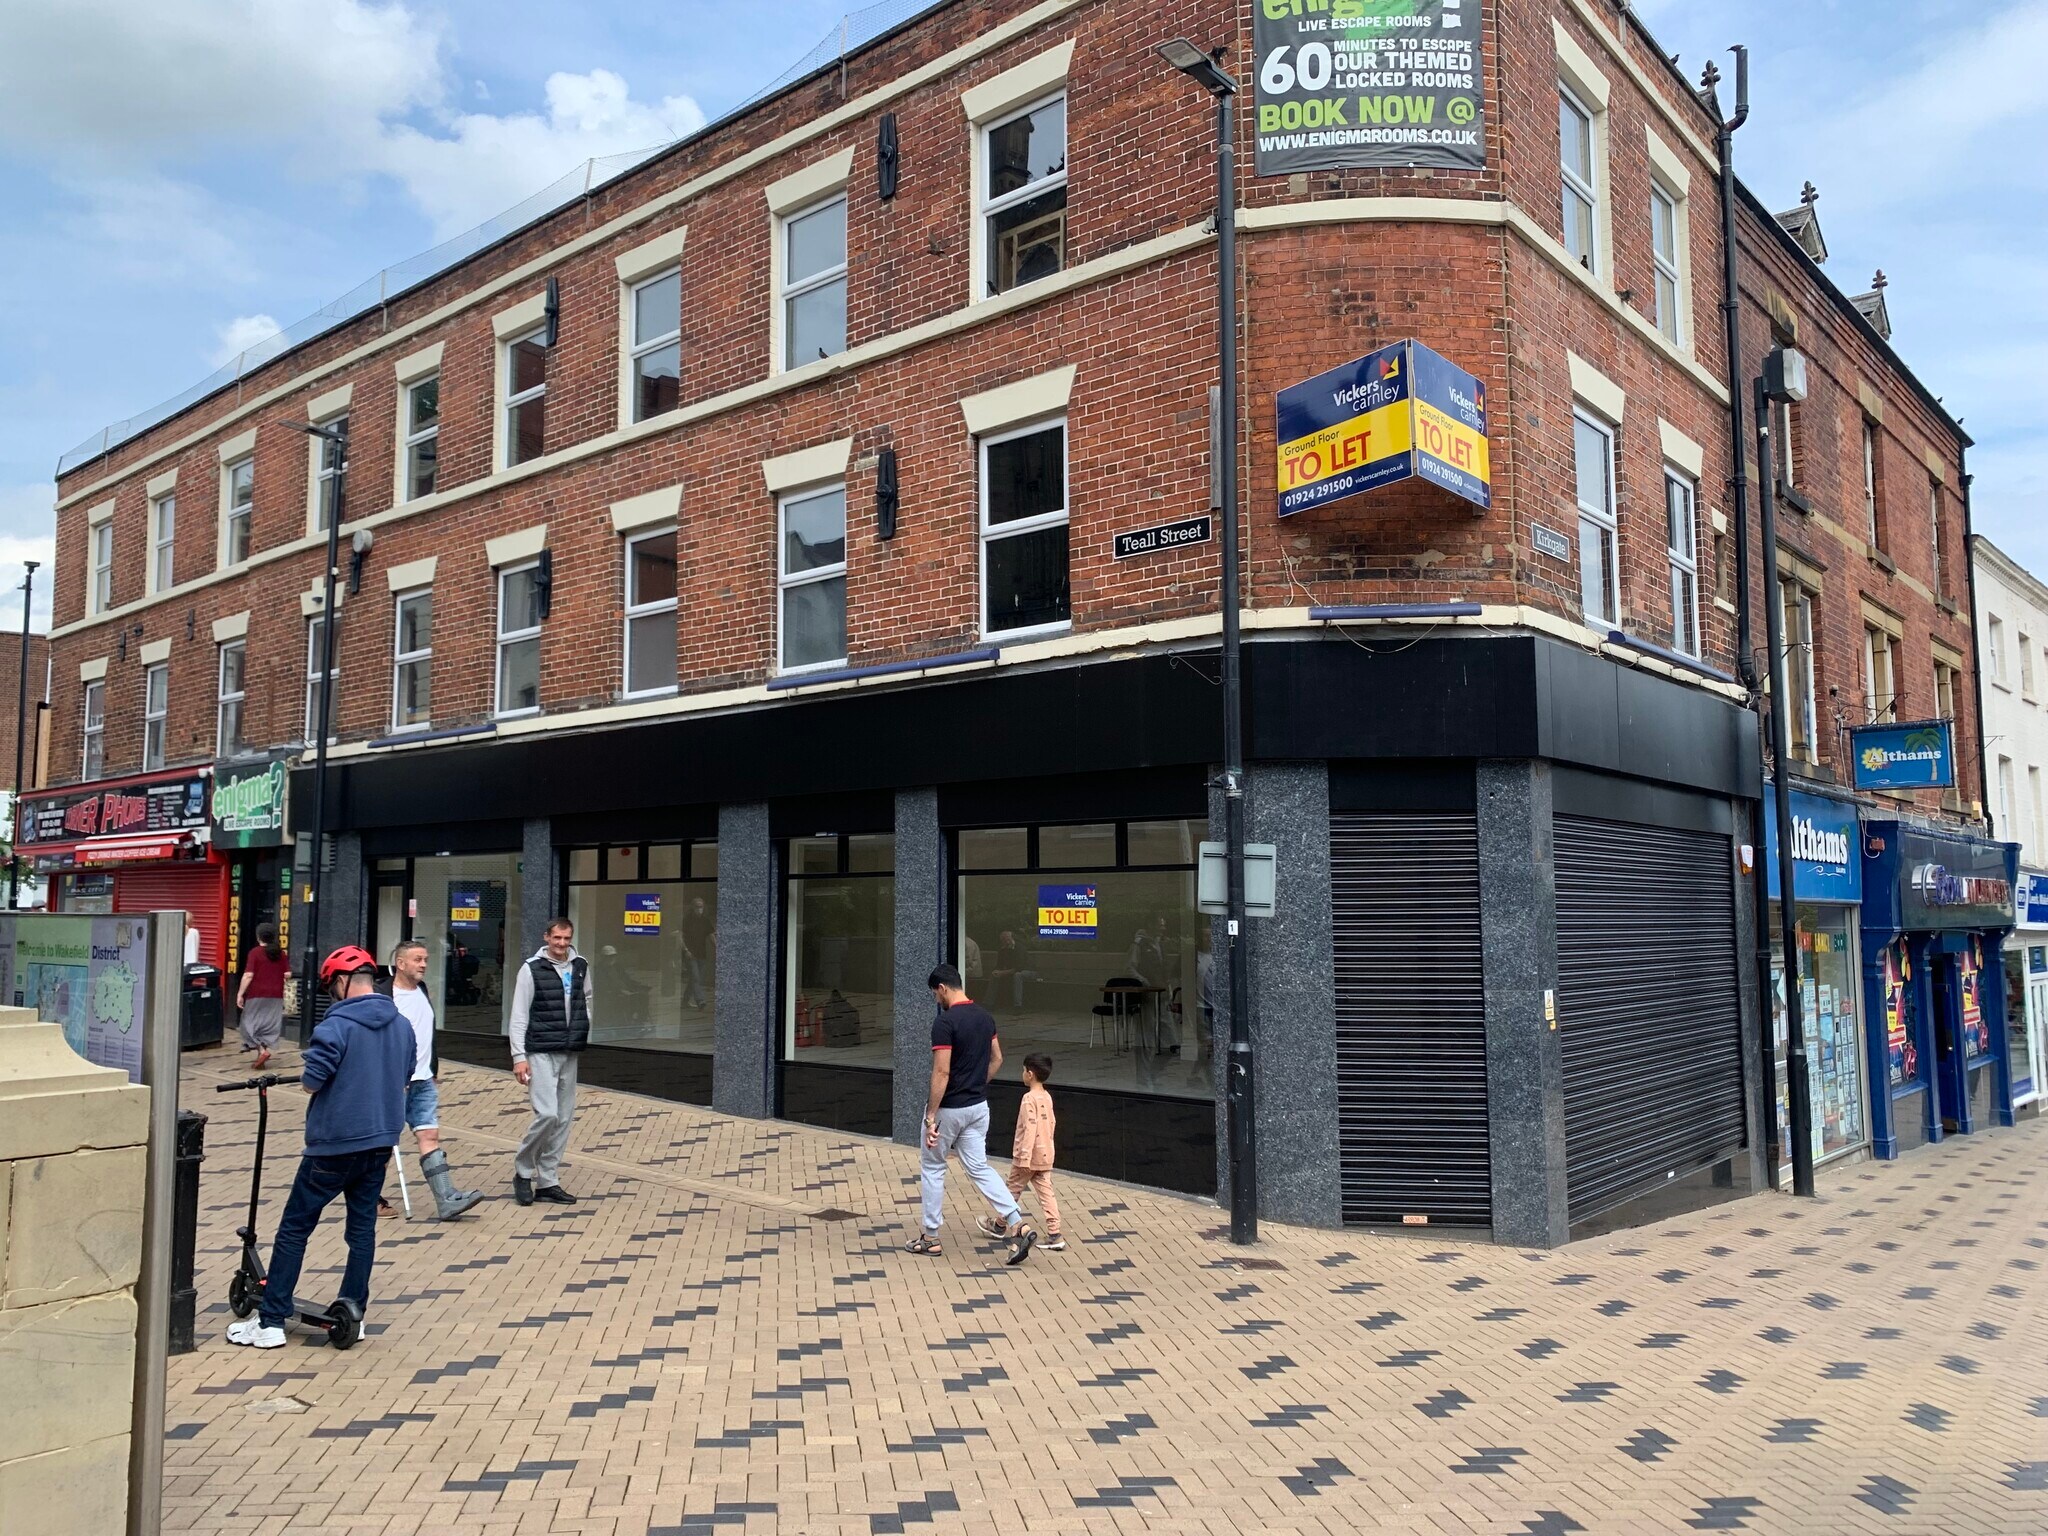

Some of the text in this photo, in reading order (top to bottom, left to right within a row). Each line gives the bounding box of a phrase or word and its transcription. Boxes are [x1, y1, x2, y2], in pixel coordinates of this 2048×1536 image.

[1298, 16, 1431, 33] LIVE ESCAPE ROOMS
[1334, 38, 1472, 53] MINUTES TO ESCAPE
[1260, 42, 1332, 95] 60
[1335, 52, 1472, 71] OUR THEMED
[1336, 72, 1473, 89] LOCKED ROOMS
[1260, 95, 1475, 133] BOOK NOW @
[1259, 128, 1478, 153] WWW.ENIGMAROOMS.CO.UK
[1333, 379, 1379, 407] Vickers
[1353, 384, 1400, 412] carnley
[1449, 386, 1476, 412] Vickers
[1419, 404, 1454, 431] Ground Floor
[1460, 408, 1485, 434] carnley
[1284, 429, 1340, 457] Ground Floor
[1420, 418, 1472, 470] TO LET
[1285, 430, 1371, 485] TO LET
[1422, 456, 1462, 487] 01924 291500
[1285, 462, 1404, 508] 01924 291500 vickerscarnley.co.uk
[1122, 524, 1202, 552] Teall Street
[1536, 530, 1565, 555] Kirkgate
[1868, 749, 1942, 763] Althams
[101, 794, 147, 833] PHONES
[225, 816, 271, 829] LIVE ESCAPE ROOMS
[1790, 814, 1848, 865] lthams
[1066, 893, 1088, 902] Vickers
[279, 895, 291, 955] ESCA
[455, 910, 476, 919] TO LET
[629, 913, 656, 924] TO LET
[1046, 910, 1089, 923] TO LET
[227, 896, 240, 974] ESCAPE
[17, 943, 46, 957] Welcome
[47, 944, 54, 957] to
[55, 944, 89, 959] Wakefield
[92, 945, 120, 960] District
